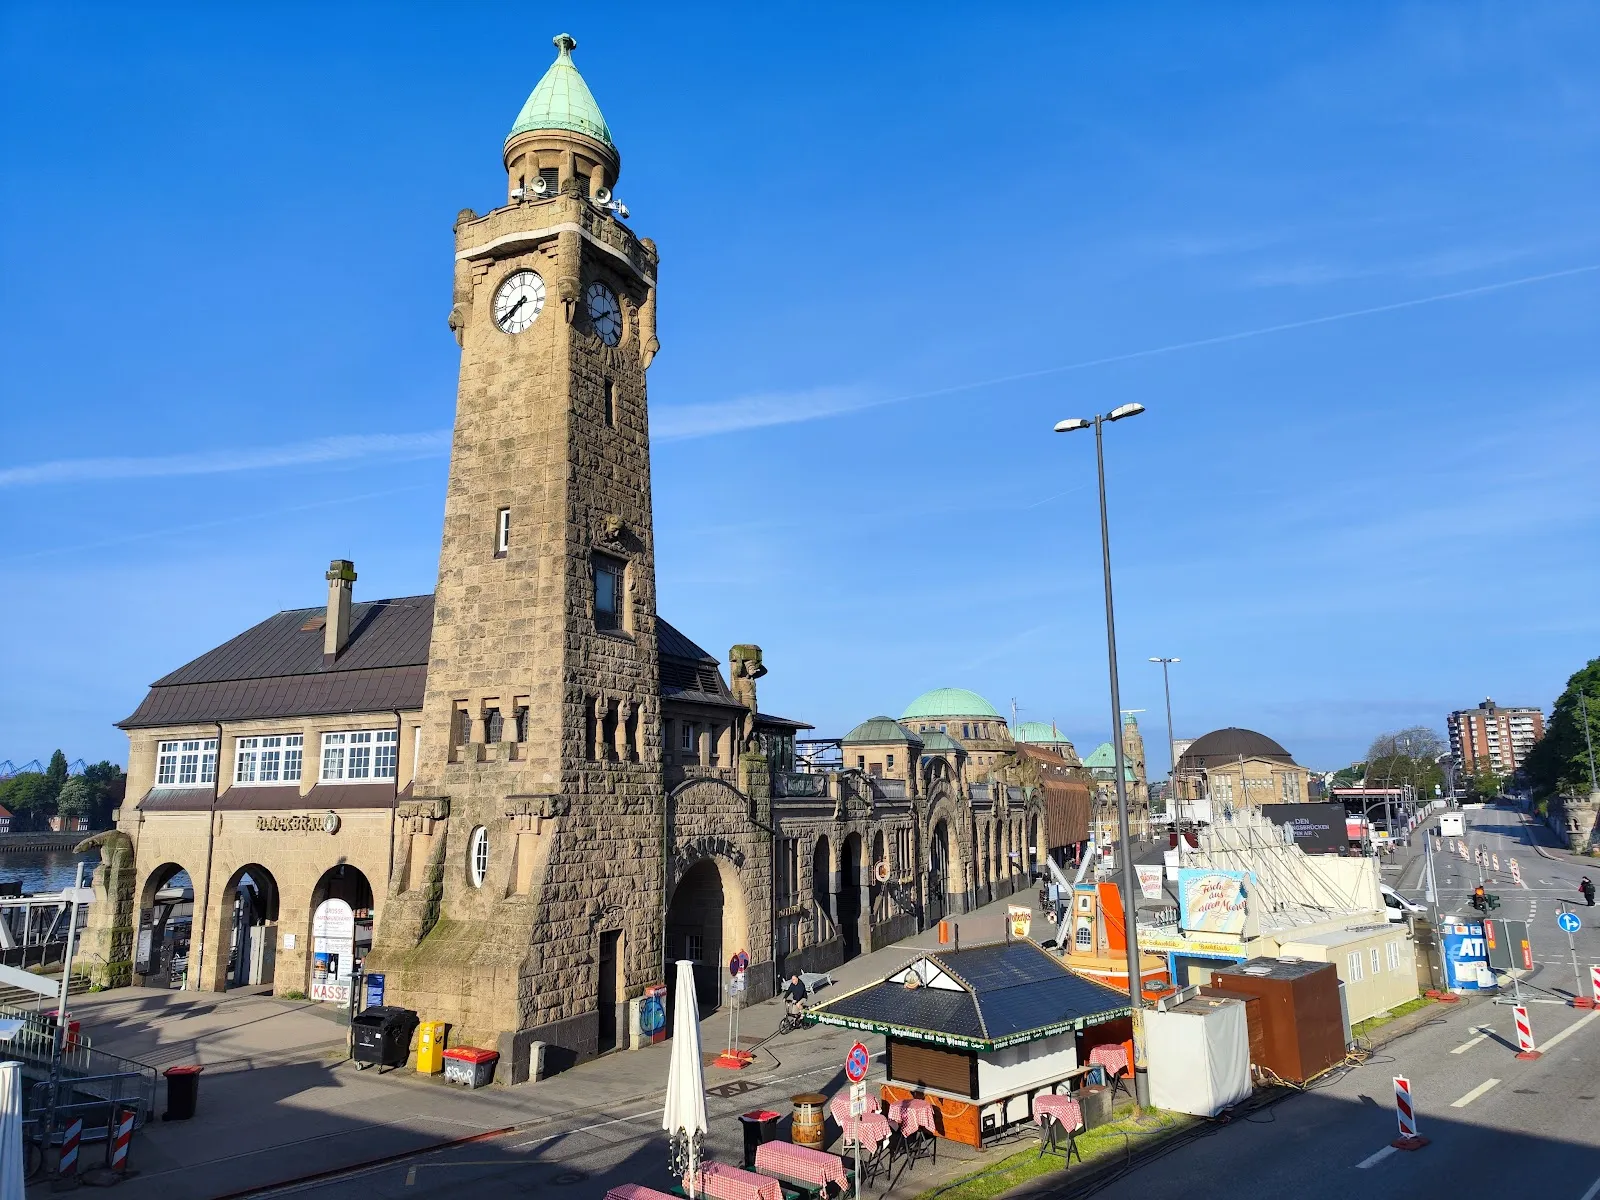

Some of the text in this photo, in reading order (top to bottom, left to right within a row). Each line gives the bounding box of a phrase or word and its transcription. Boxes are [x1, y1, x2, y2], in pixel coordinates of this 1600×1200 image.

[1200, 880, 1224, 895] Fisch
[1208, 892, 1224, 900] aus
[1198, 901, 1220, 913] allen
[1459, 938, 1487, 956] AT
[313, 985, 349, 1000] KASSE
